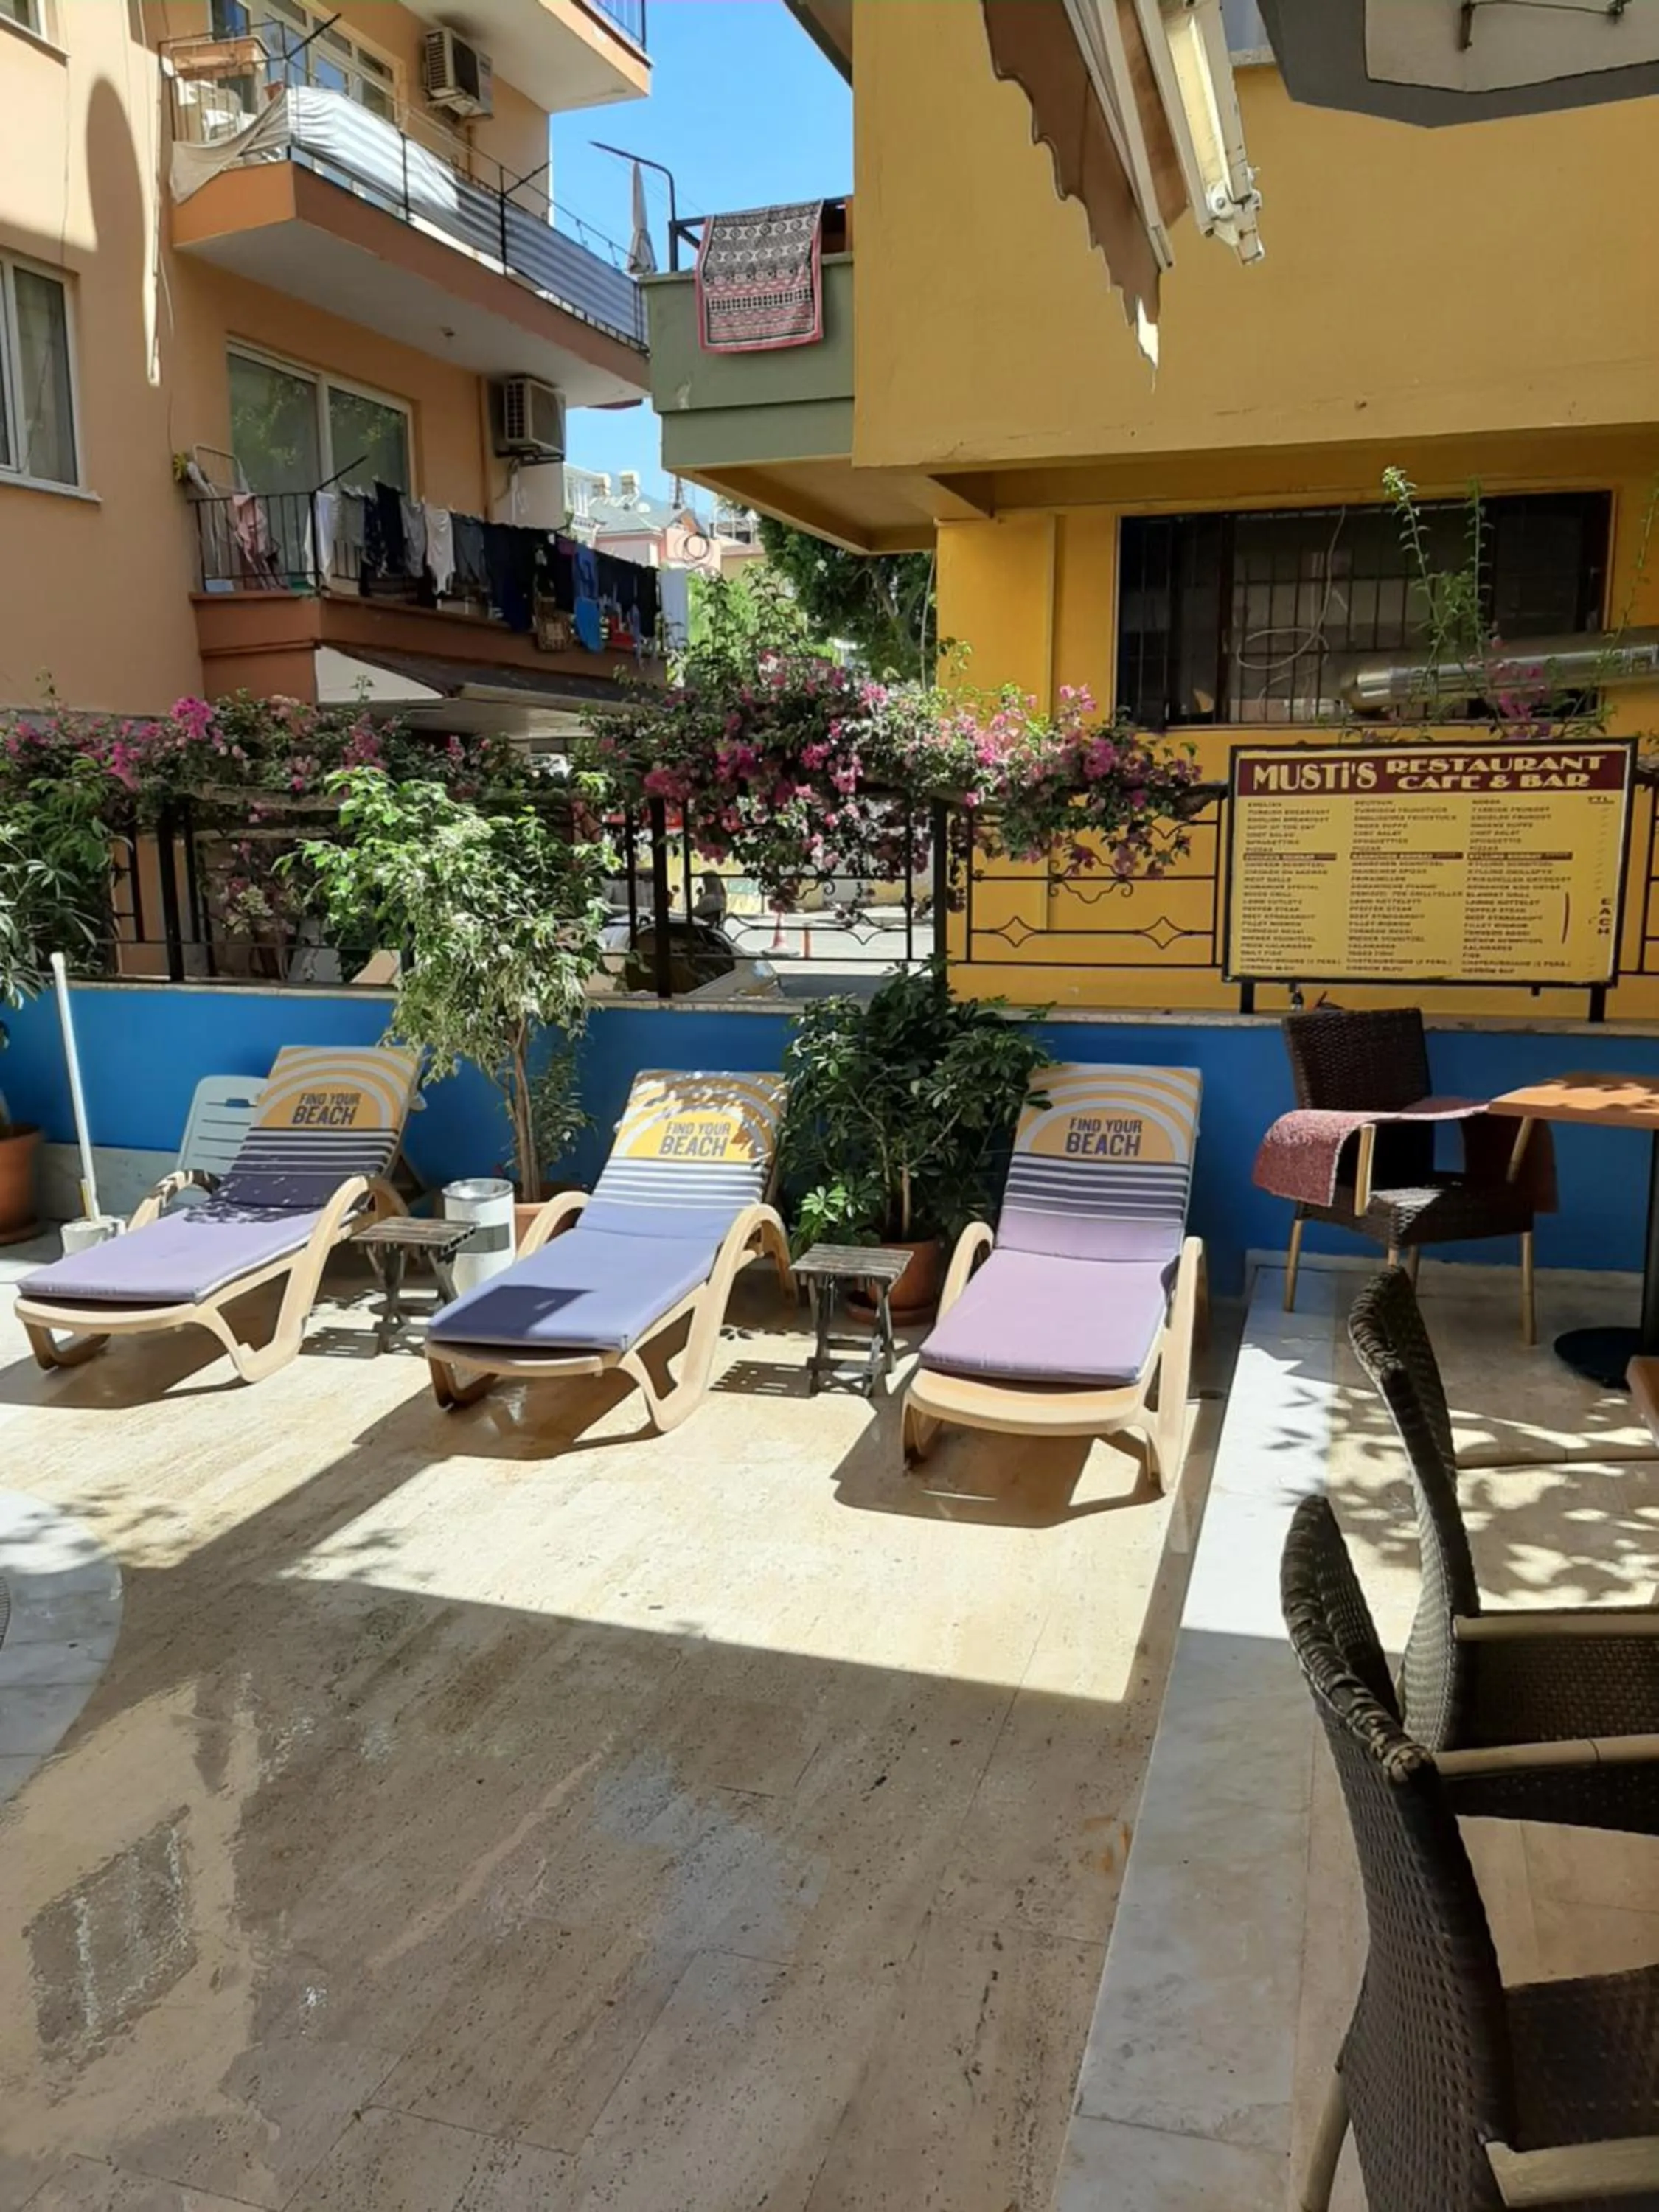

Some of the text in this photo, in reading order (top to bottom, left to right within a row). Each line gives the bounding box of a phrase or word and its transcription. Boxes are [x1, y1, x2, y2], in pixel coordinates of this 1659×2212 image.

[1385, 754, 1607, 773] RESTAURANT
[1397, 773, 1590, 790] CAFE & BAR
[299, 1092, 362, 1105] FIND YOUR
[292, 1105, 358, 1125] BEACH
[665, 1121, 731, 1135] FIND YOUR
[1069, 1118, 1143, 1133] FIND YOUR
[658, 1135, 728, 1157] BEACH
[1065, 1132, 1142, 1157] BEACH
